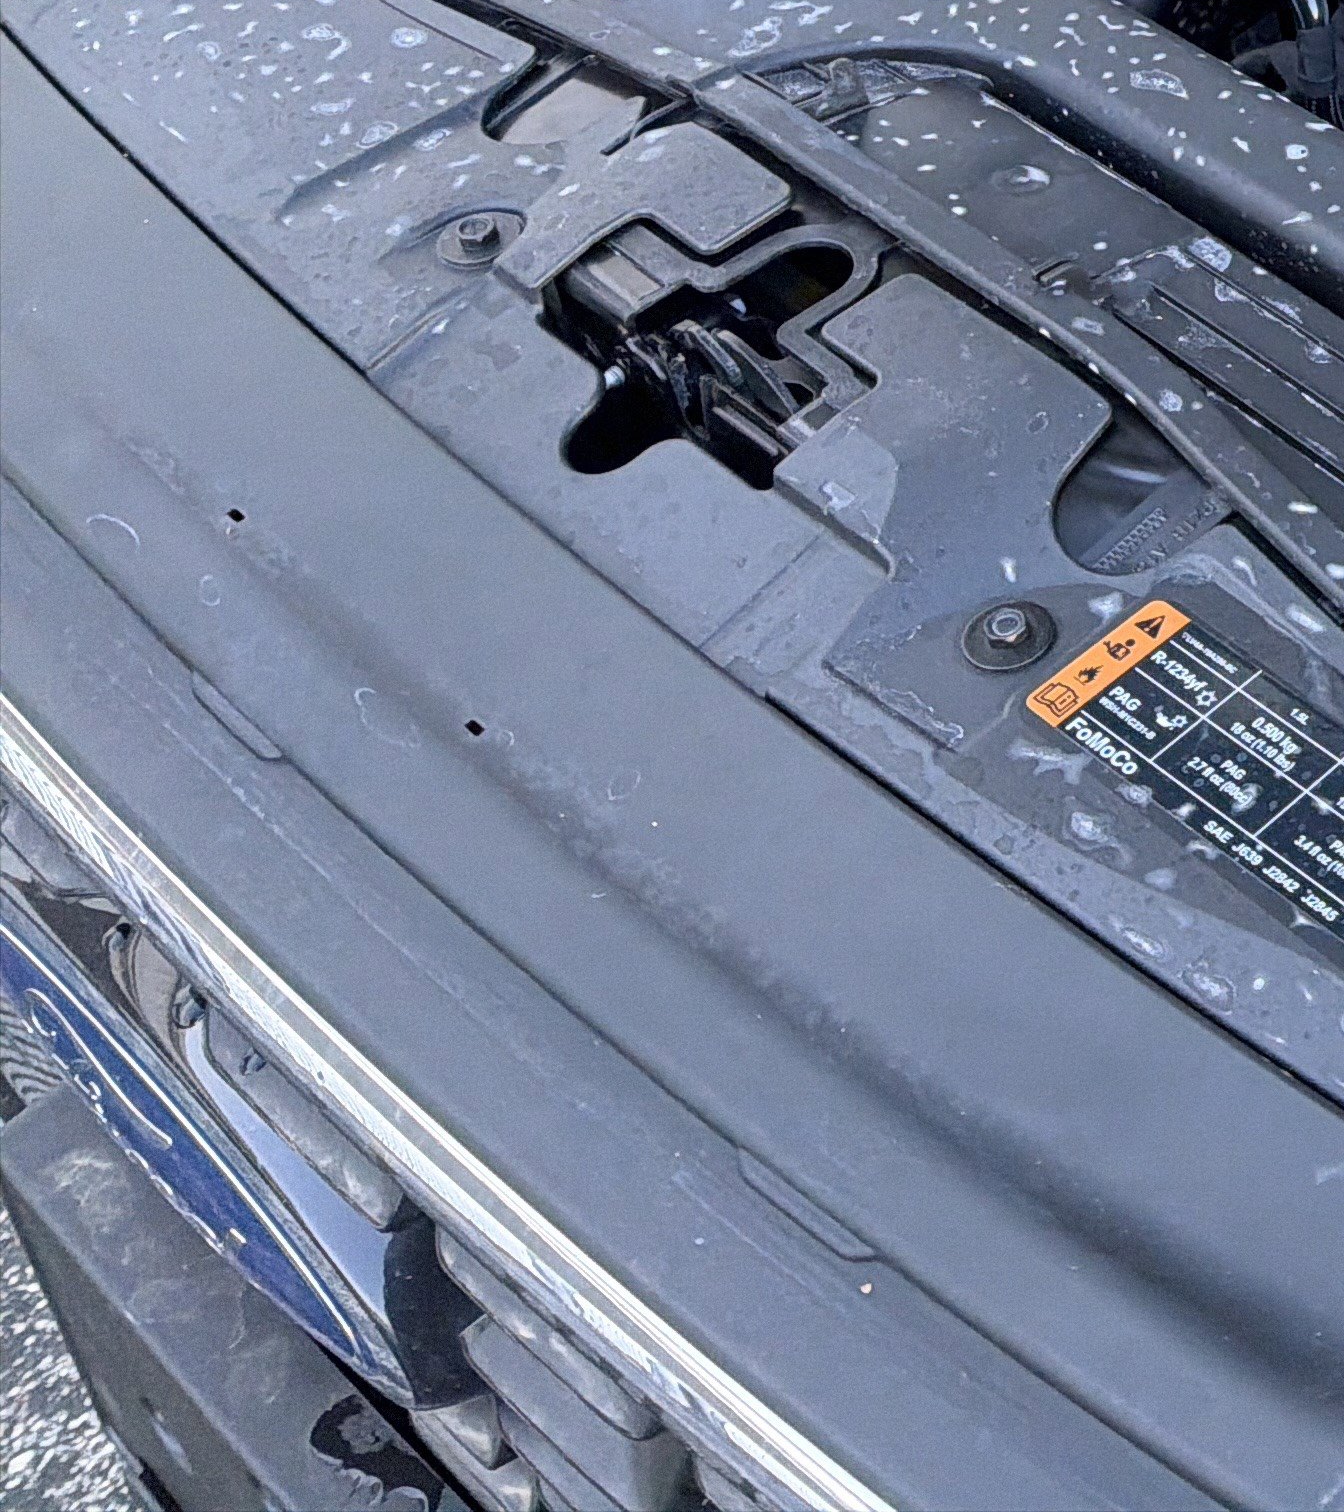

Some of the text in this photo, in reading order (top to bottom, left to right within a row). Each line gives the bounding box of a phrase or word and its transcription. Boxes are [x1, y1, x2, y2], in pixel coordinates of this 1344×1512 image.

[1149, 651, 1208, 694] R-1234yf
[1109, 687, 1142, 711] PAG
[1064, 718, 1142, 774] FoMoCo
[1229, 722, 1295, 771] 18 oz (1.10 lbs)
[1252, 718, 1300, 754] 0.500 kg
[1186, 756, 1206, 771] 2.7
[1208, 774, 1224, 785] oz
[1219, 782, 1253, 806] (80cc)
[1219, 759, 1247, 780] PAG
[1203, 821, 1339, 921] SAE J639 J2842 J2845
[1292, 835, 1312, 850] 3.4
[1315, 853, 1331, 865] oz
